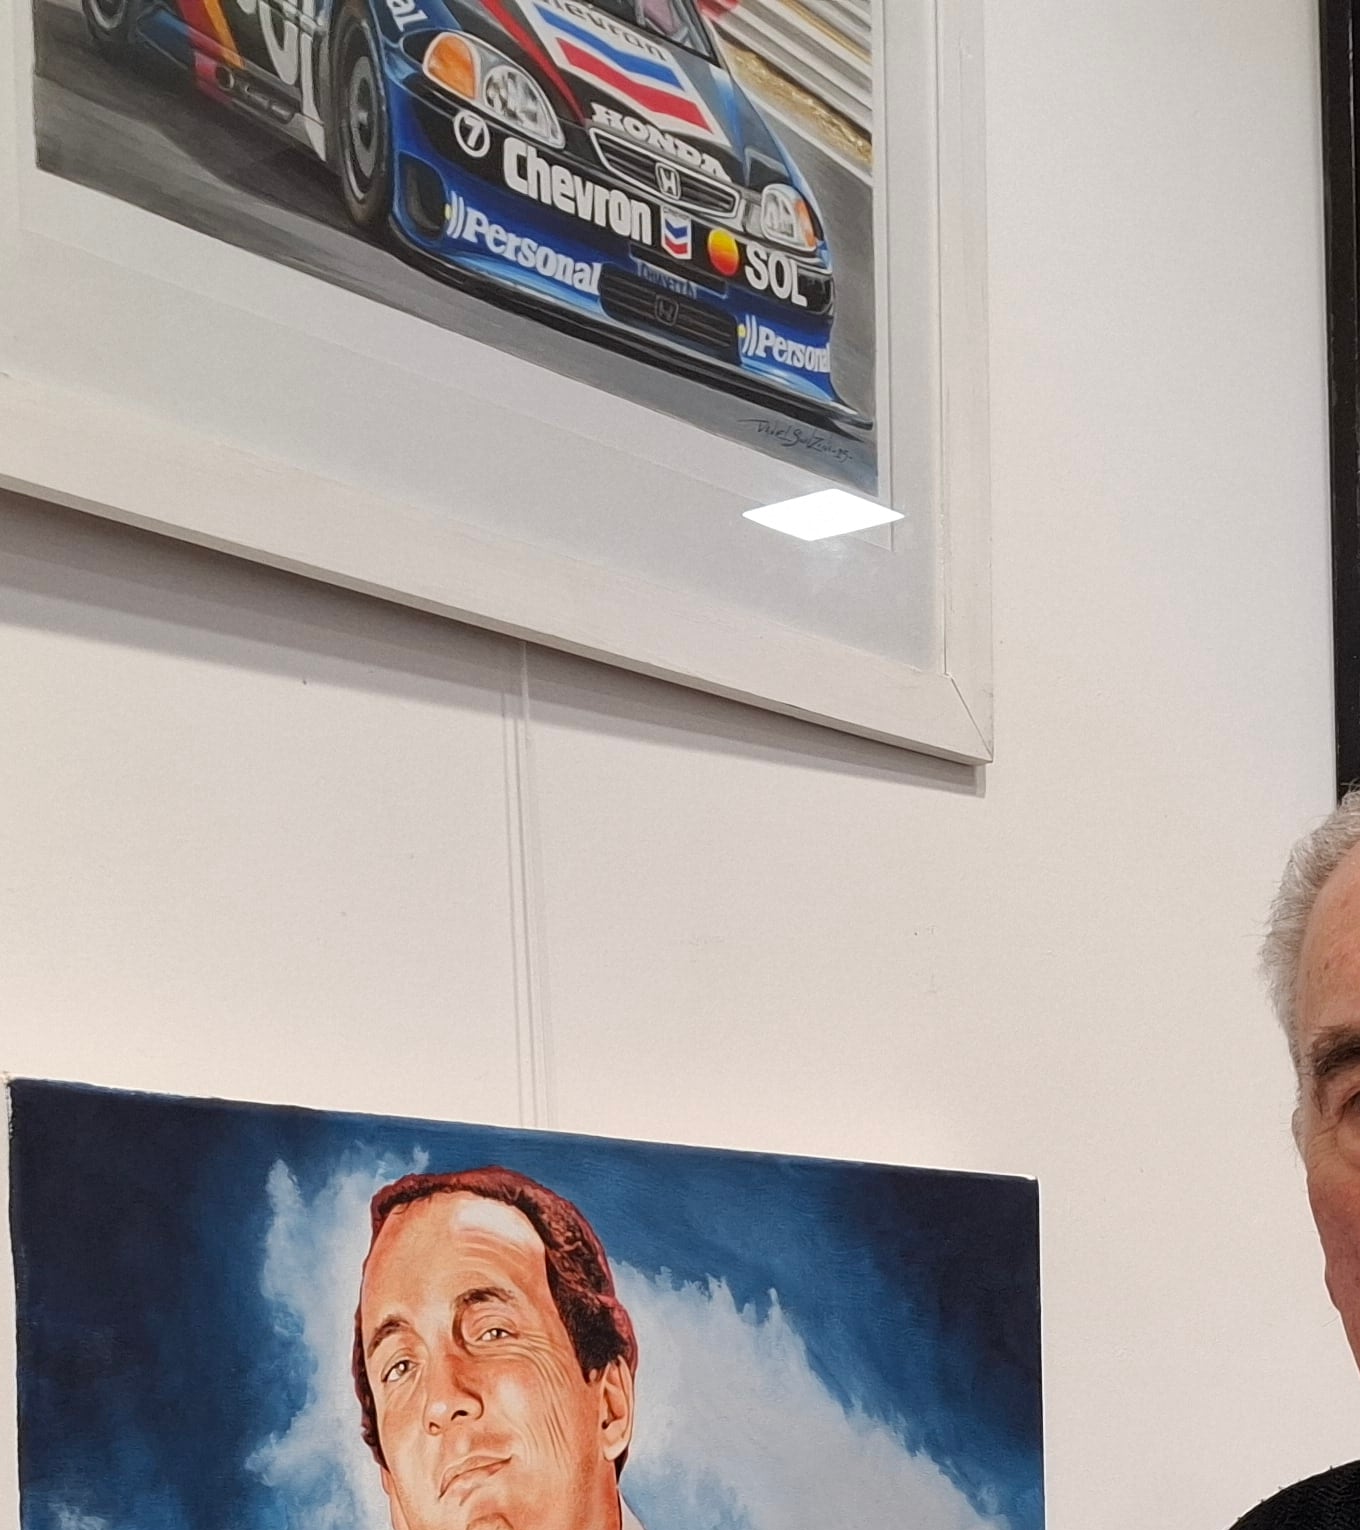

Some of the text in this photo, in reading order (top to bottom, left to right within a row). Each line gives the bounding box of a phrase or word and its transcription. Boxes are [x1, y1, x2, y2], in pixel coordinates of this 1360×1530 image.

[591, 102, 731, 181] HONDA
[504, 137, 652, 245] Chevron
[461, 206, 603, 295] Personal
[744, 241, 808, 307] SOL
